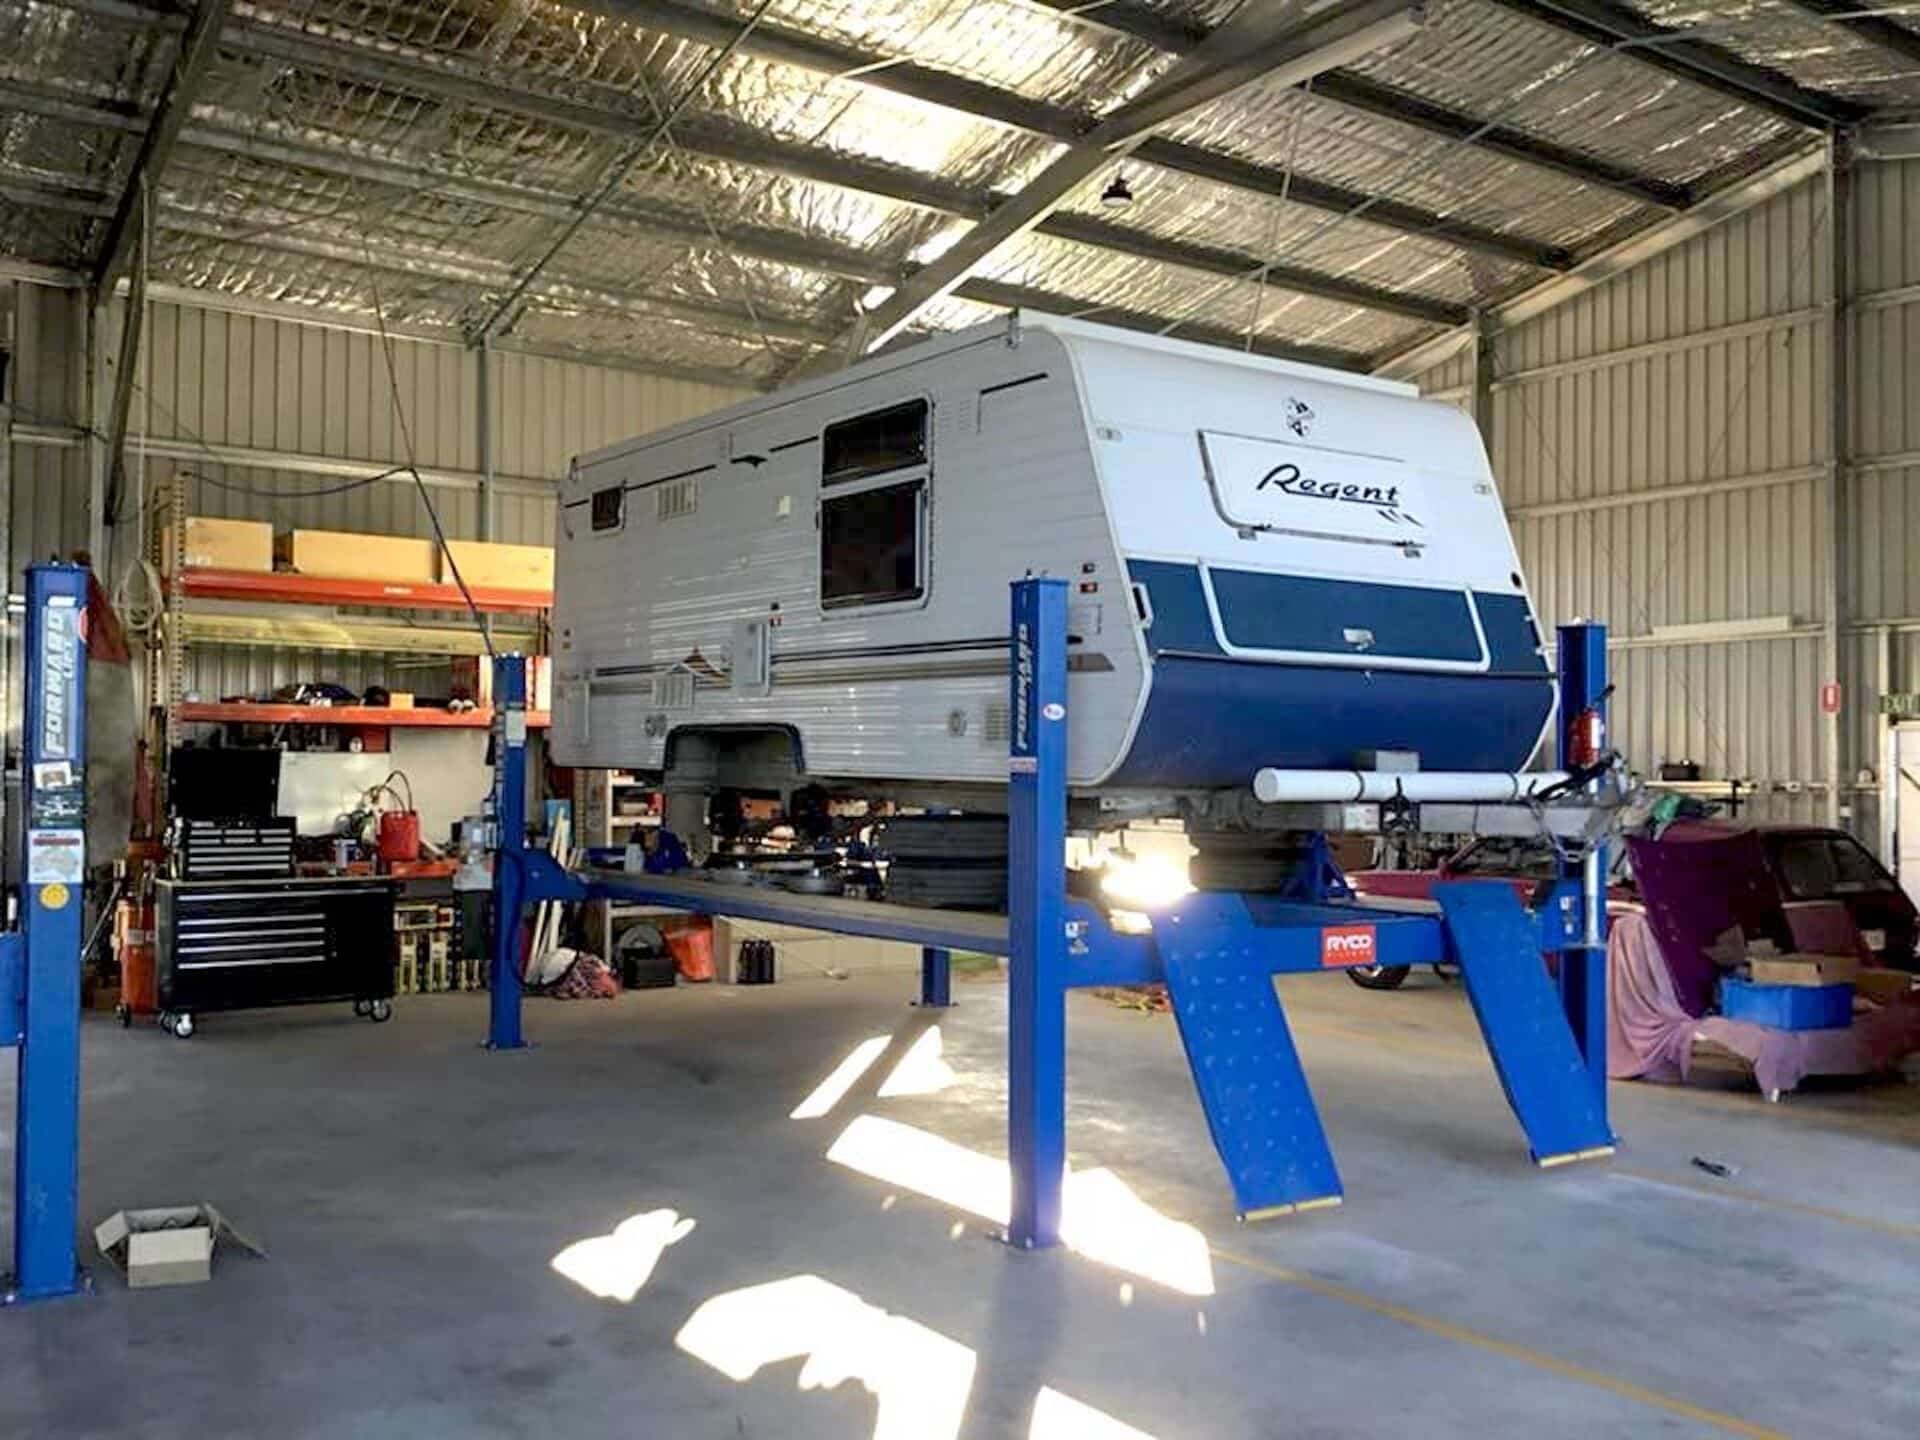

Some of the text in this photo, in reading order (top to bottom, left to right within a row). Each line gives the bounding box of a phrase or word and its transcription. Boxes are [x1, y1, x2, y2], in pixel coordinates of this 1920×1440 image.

[1257, 464, 1399, 506] Regent
[45, 612, 65, 755] FORWARD
[1017, 623, 1029, 750] FORWARD
[1327, 934, 1372, 951] RYCO
